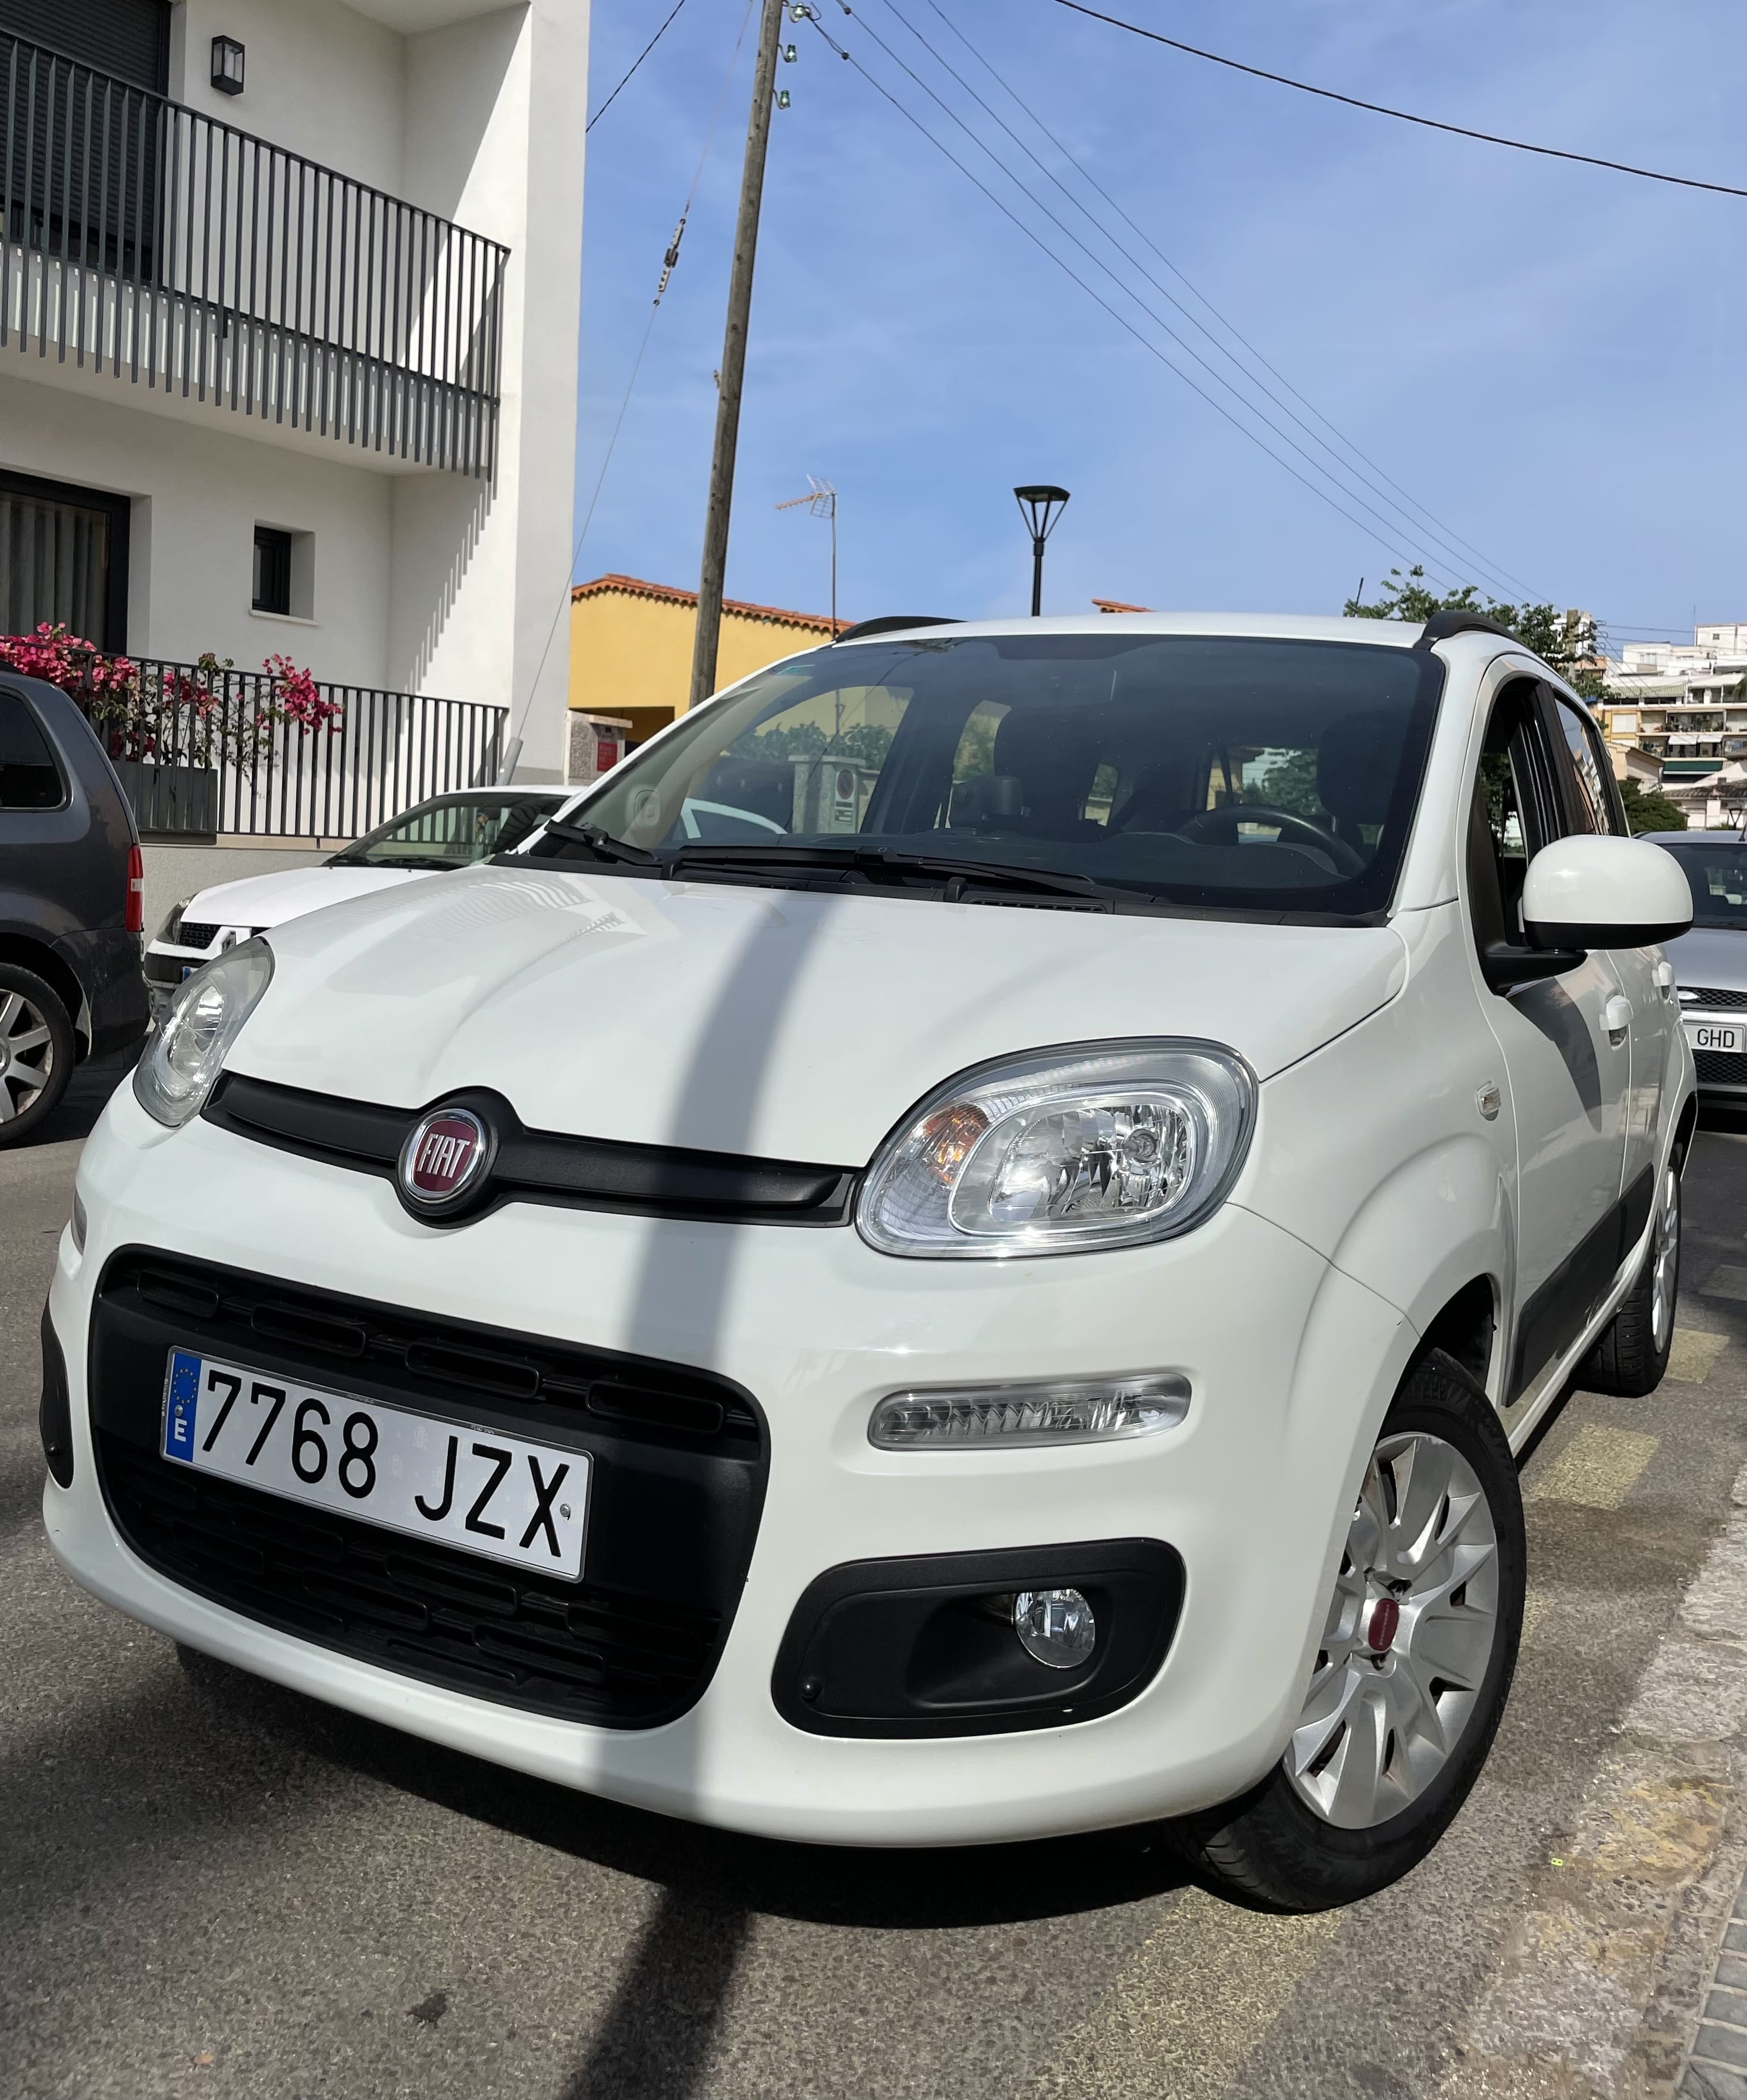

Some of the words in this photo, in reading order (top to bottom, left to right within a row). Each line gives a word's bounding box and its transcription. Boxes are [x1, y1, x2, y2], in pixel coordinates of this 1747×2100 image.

[1698, 1029, 1734, 1048] GHD
[416, 1133, 471, 1178] FIAT
[174, 1418, 187, 1442] E
[202, 1369, 379, 1499] 7768
[415, 1435, 570, 1557] JZX
